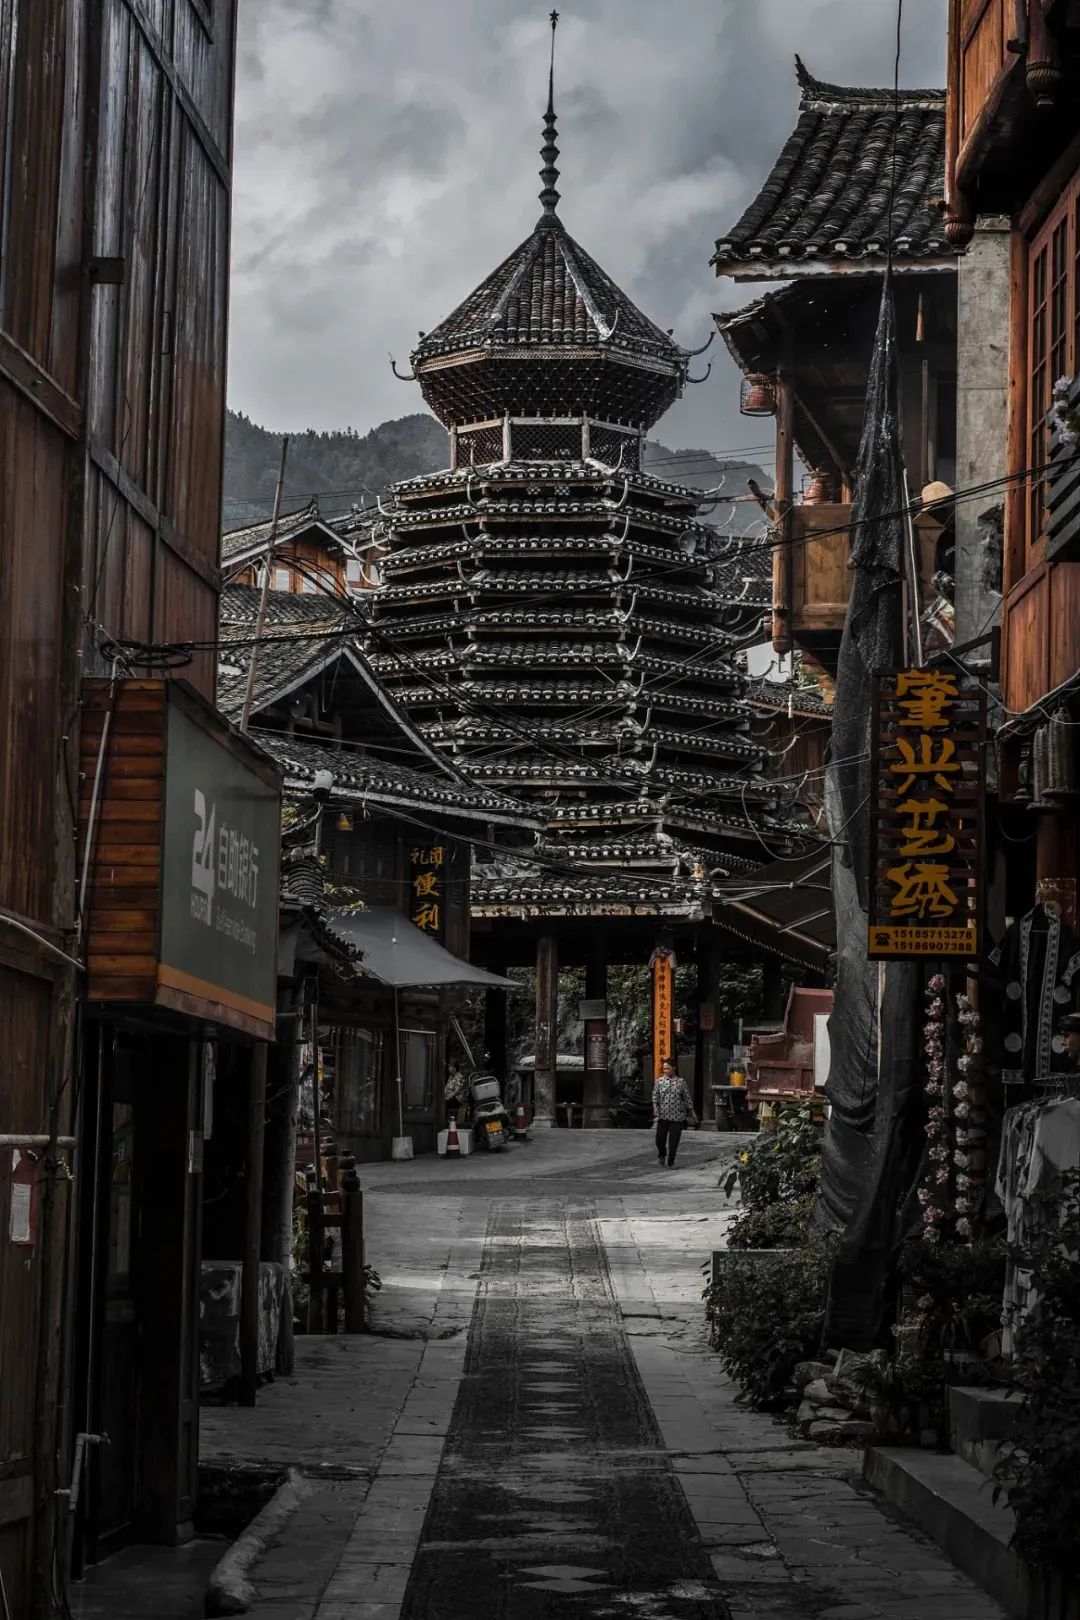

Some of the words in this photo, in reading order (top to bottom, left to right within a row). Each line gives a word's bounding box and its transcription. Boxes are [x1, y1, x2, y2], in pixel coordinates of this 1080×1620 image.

[887, 670, 961, 919] 肇兴艺绣
[192, 788, 216, 926] 24
[217, 821, 259, 909] 自助银行
[893, 929, 973, 940] 15185713278
[893, 941, 973, 952] 15186907388
